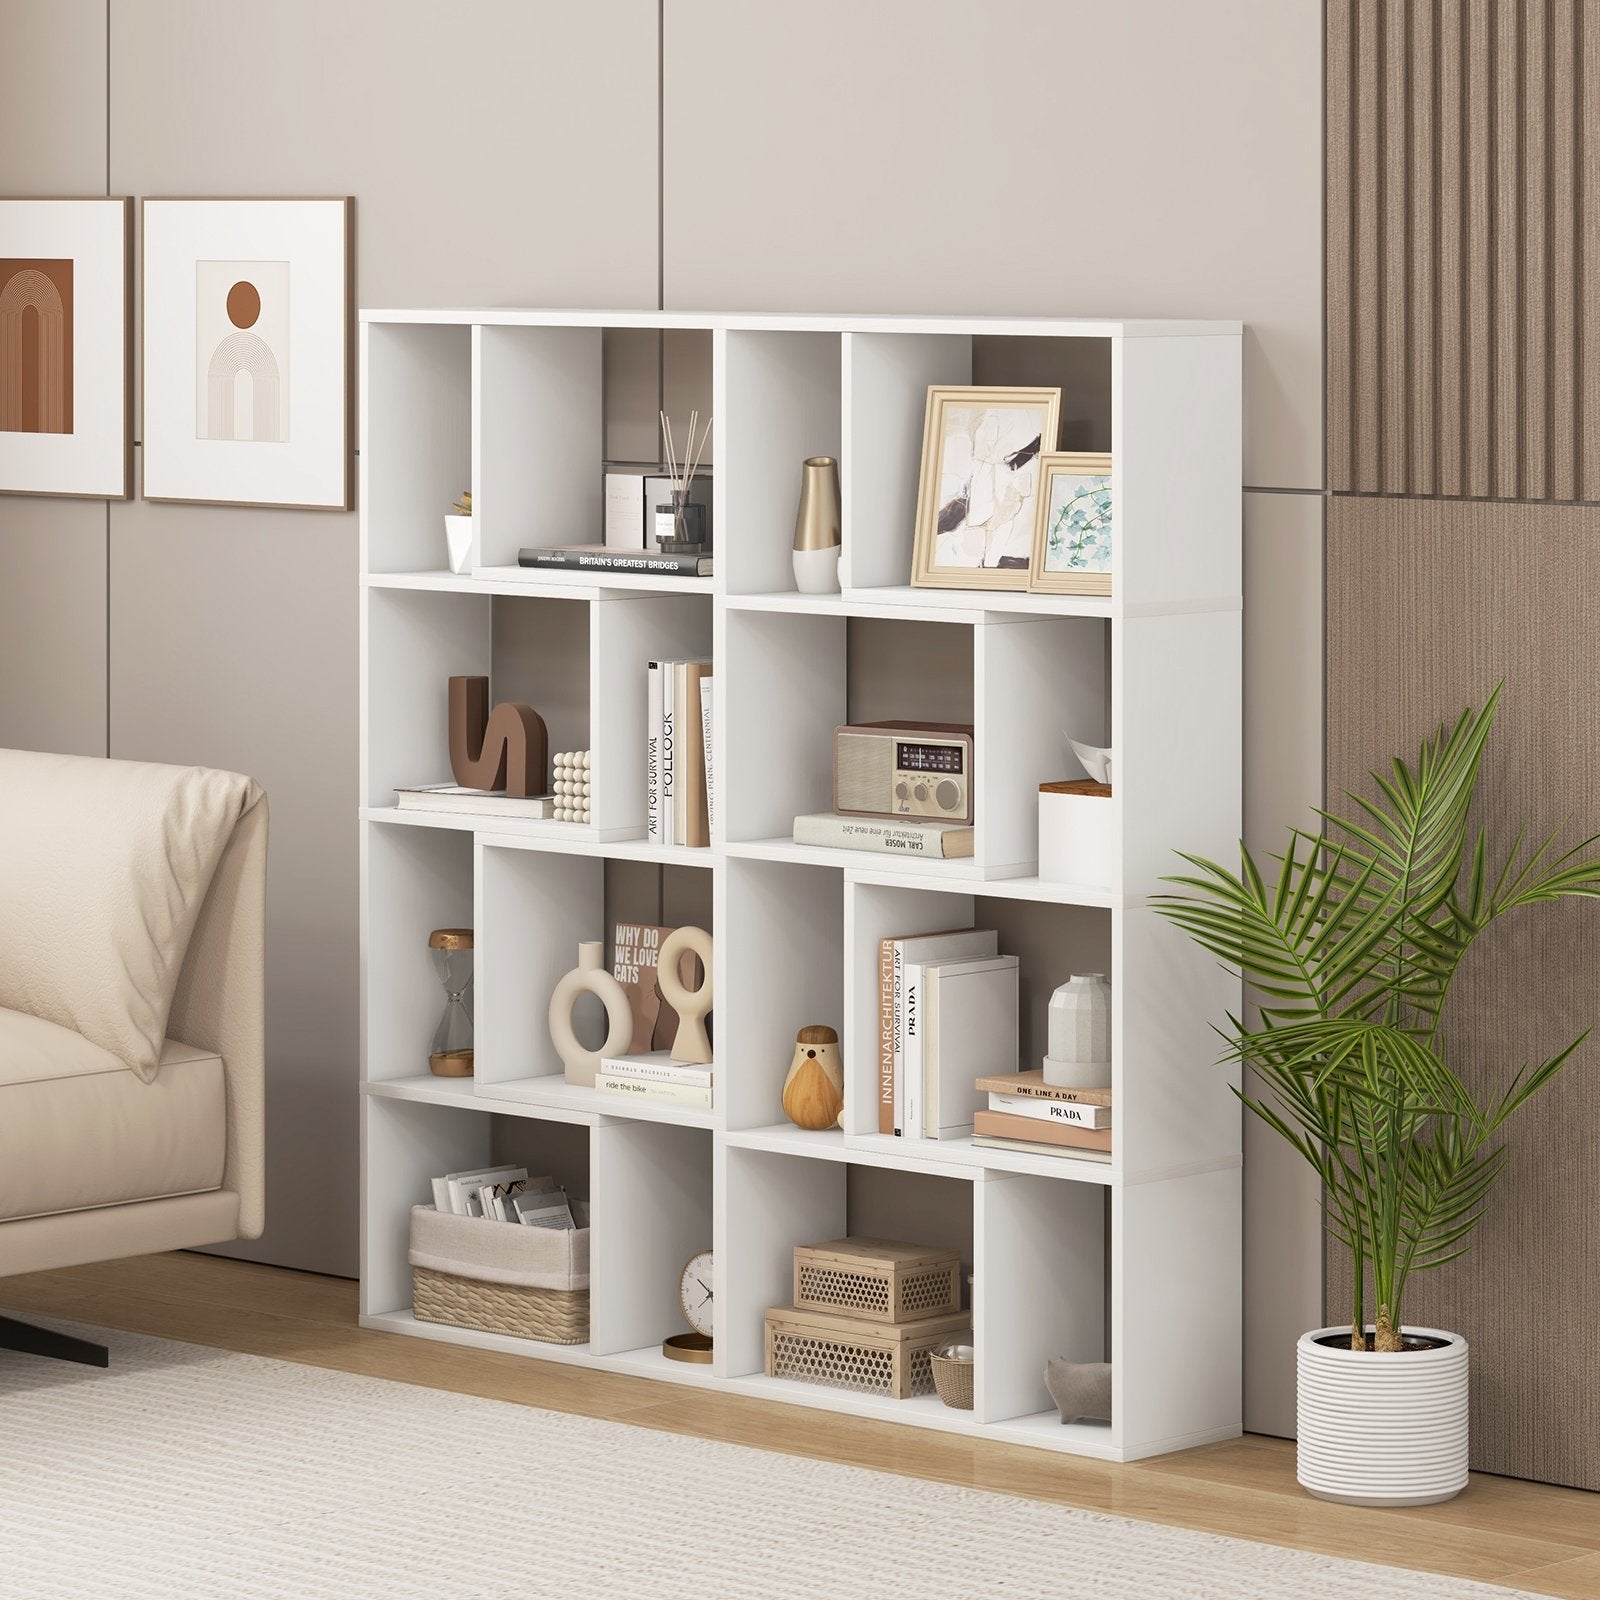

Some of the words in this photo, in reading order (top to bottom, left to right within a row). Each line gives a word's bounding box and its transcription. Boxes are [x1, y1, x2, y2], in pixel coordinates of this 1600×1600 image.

[579, 557, 612, 567] BRITAIN'S
[612, 559, 647, 568] GREATEST
[648, 560, 679, 570] BRIDGES
[649, 737, 657, 786] SURVIVAL
[663, 712, 673, 798] POLLOCK
[649, 788, 657, 811] FOR
[649, 815, 657, 835] ART
[842, 825, 854, 835] Zeit
[854, 826, 868, 834] neue
[869, 827, 882, 837] eine
[892, 830, 924, 841] Architektur
[884, 838, 906, 849] MOSER
[908, 840, 924, 850] CARL
[615, 924, 641, 947] WHY
[643, 928, 659, 949] DO
[614, 945, 631, 965] WE
[633, 948, 658, 968] LOVE
[613, 964, 639, 984] CATS
[908, 985, 916, 1036] PRADA
[882, 939, 893, 1104] INNENARCHITEKTUR
[605, 1080, 619, 1090] ride
[620, 1082, 631, 1092] the
[632, 1084, 647, 1094] bike
[1017, 1086, 1032, 1096] ONE
[1035, 1089, 1052, 1098] LINE
[1062, 1093, 1078, 1101] DAY
[1050, 1106, 1082, 1121] PRADA
